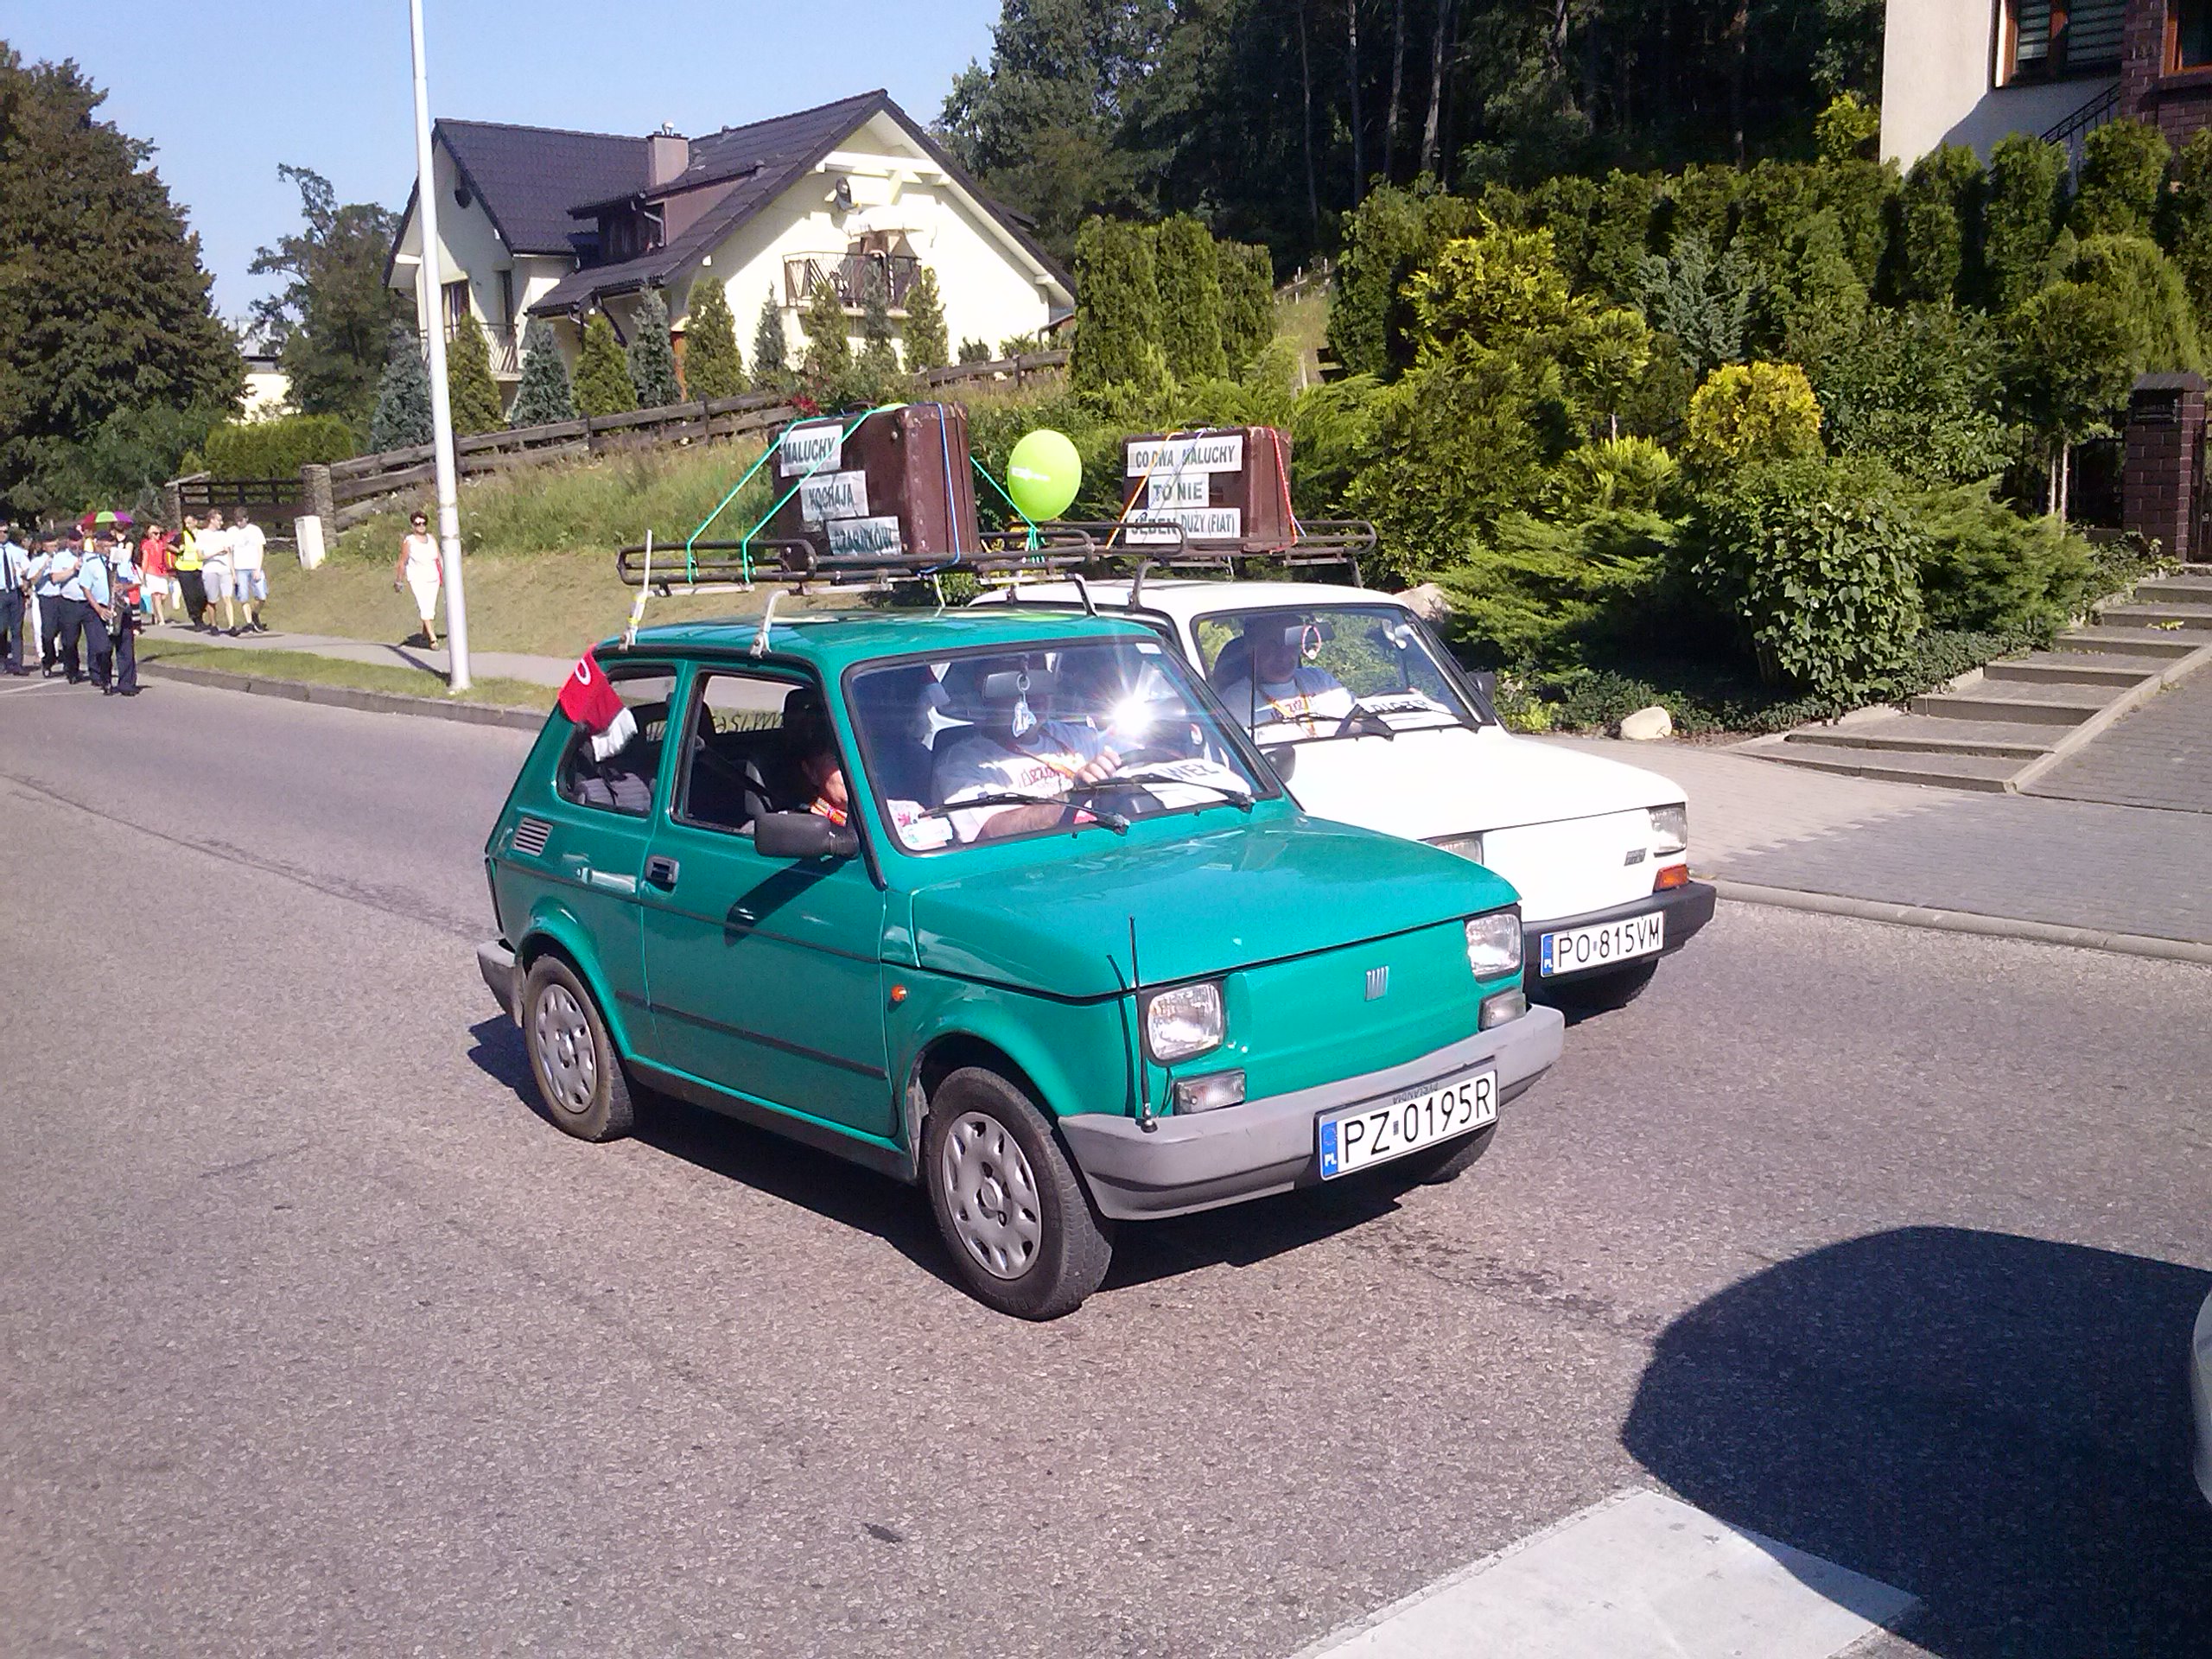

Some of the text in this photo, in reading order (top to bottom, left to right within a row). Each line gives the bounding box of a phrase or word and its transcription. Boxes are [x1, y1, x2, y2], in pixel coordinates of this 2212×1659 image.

[784, 436, 836, 464] MALUCHY
[1135, 450, 1149, 468] CO
[1183, 445, 1236, 465] MALUCHY
[1153, 481, 1203, 502] TO NIE
[1207, 513, 1235, 537] (FIAT)
[1558, 917, 1660, 968] PO 815VM
[1344, 1077, 1491, 1164] PZ 0195R
[1324, 1153, 1338, 1167] PL
